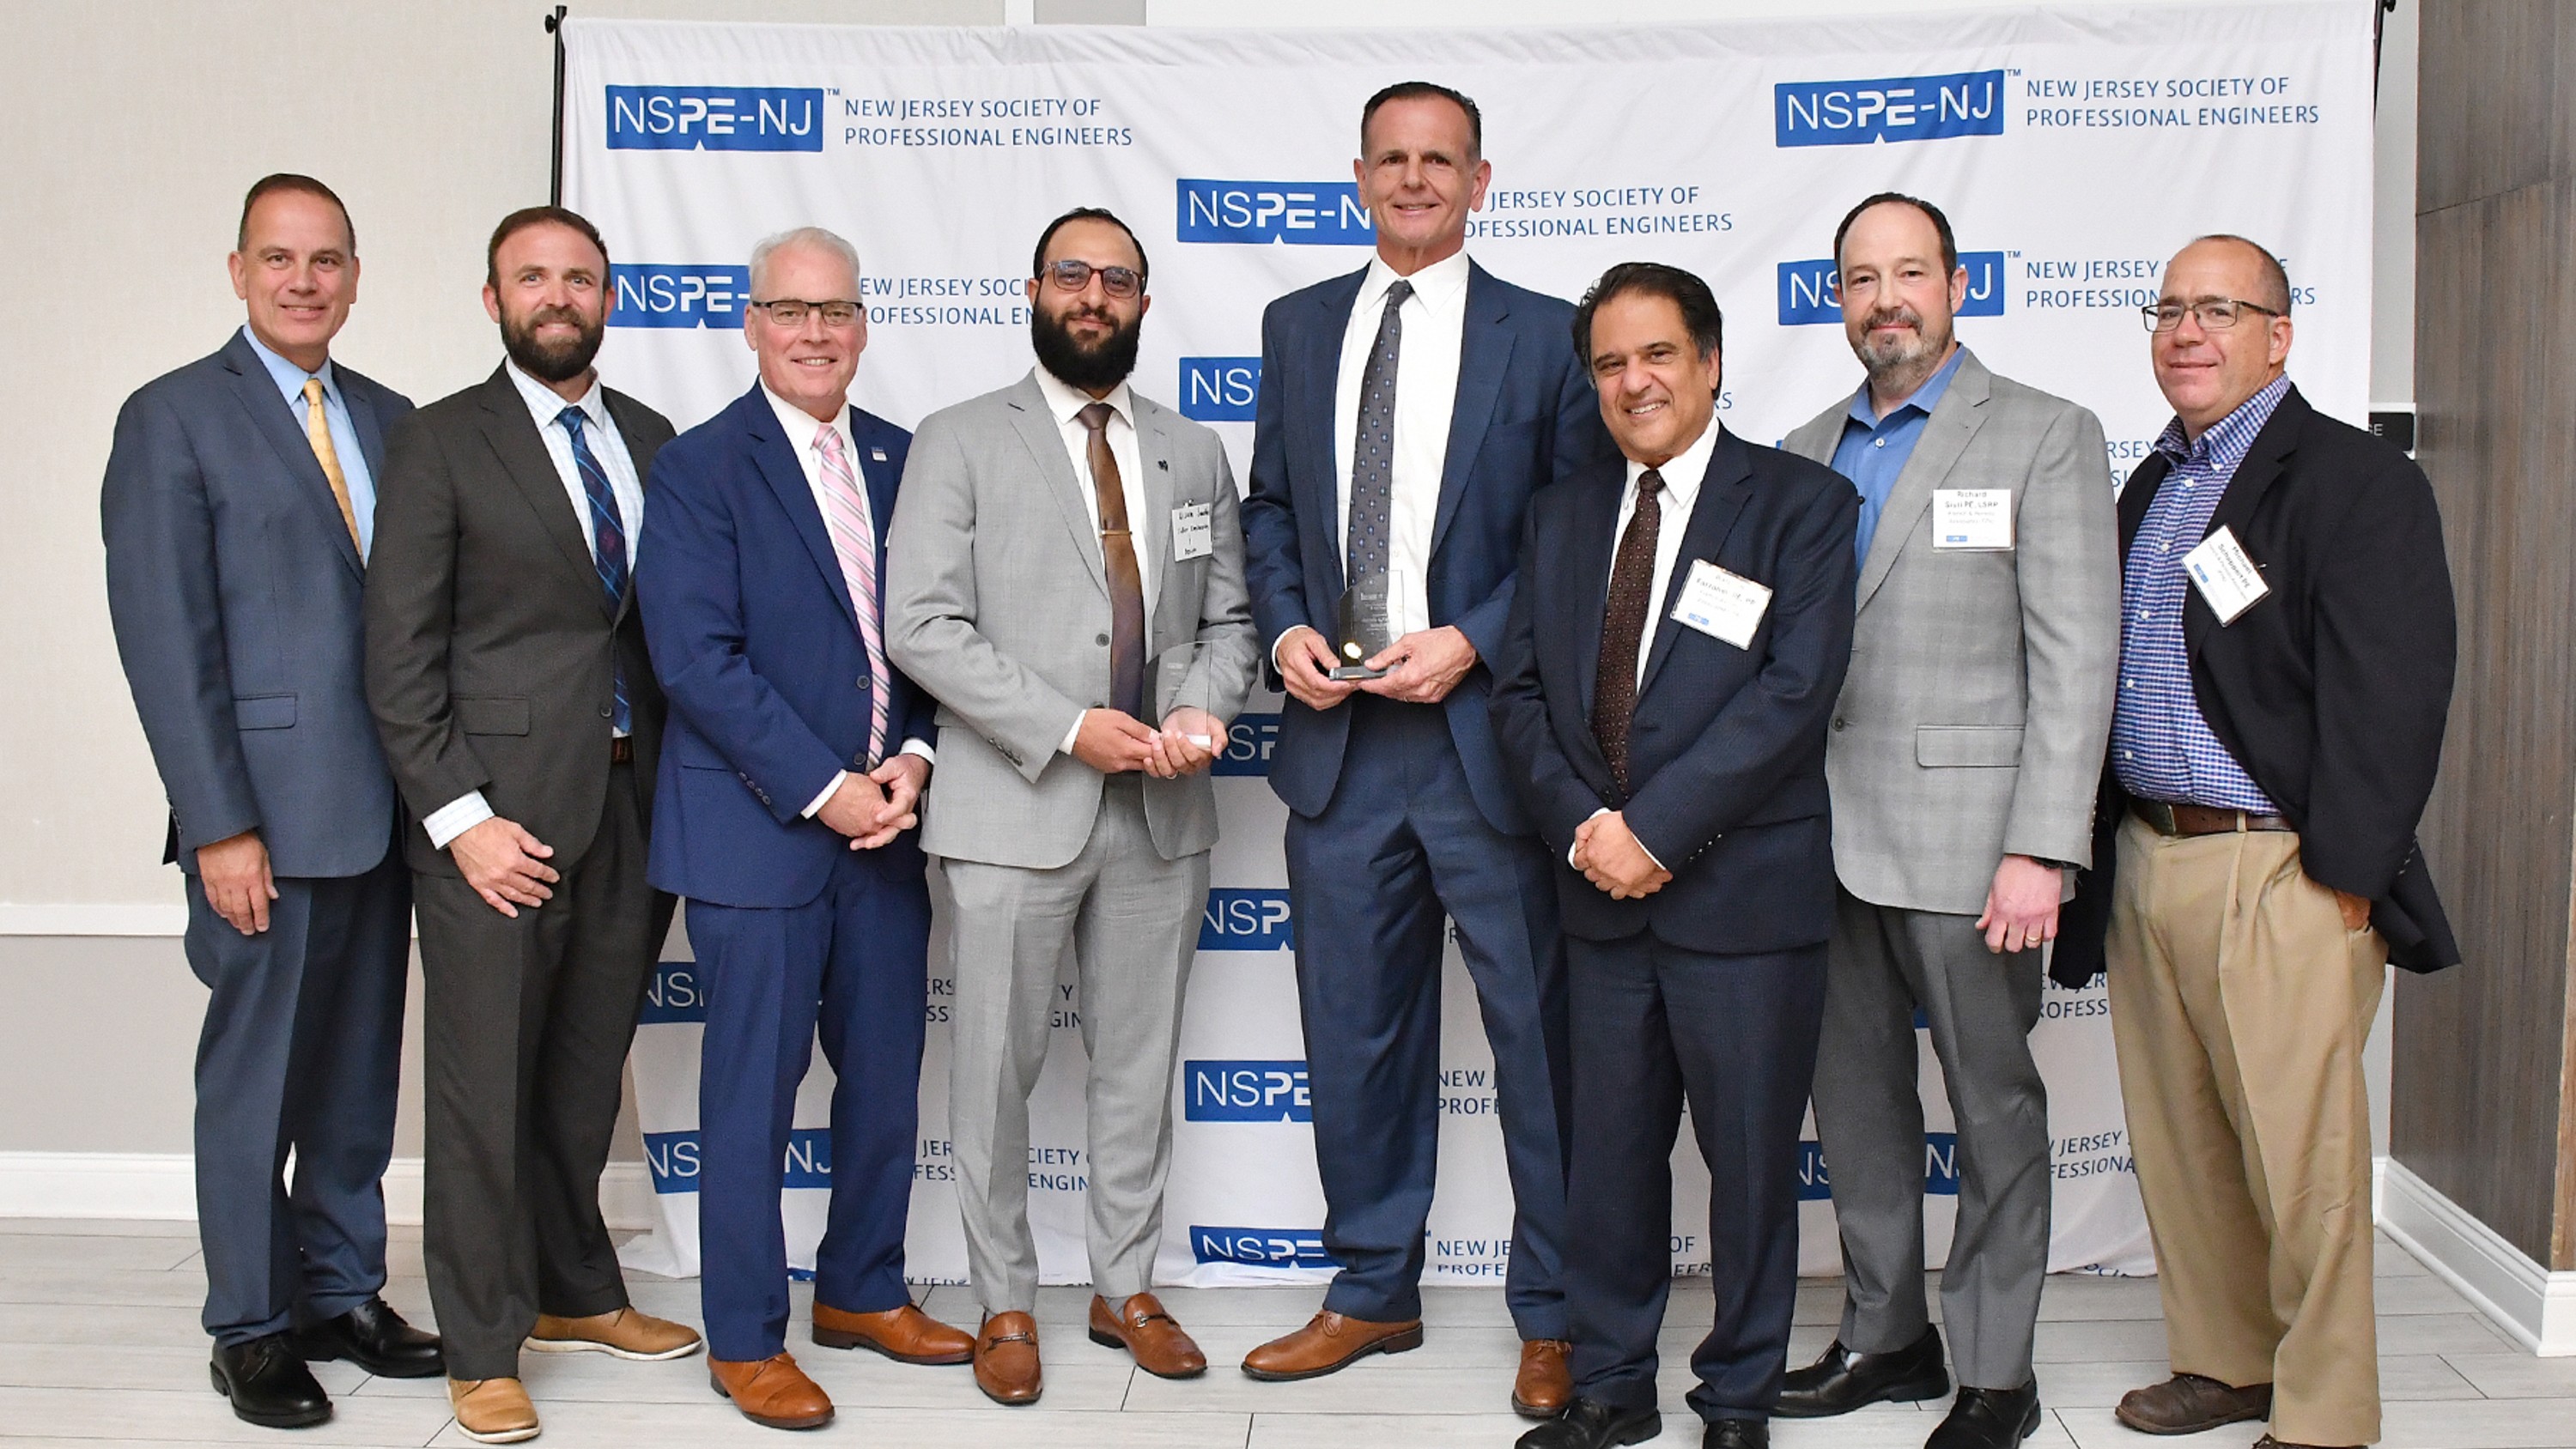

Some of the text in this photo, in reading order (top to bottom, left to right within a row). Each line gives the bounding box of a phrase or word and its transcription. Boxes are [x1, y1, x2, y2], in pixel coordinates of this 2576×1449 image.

[2026, 77, 2289, 101] NEW JERSEY SOCIETY OF
[615, 96, 811, 136] NSPE-NJ
[845, 100, 1102, 121] NEW JERSEY SOCIETY OF
[1788, 82, 1993, 130] NSPE-NJ
[2026, 106, 2319, 127] PROFESSIONAL ENGINEERS
[845, 127, 1133, 146] PROFESSIONAL ENGINEERS
[1189, 191, 1370, 229] NSPE-N
[1489, 186, 1699, 213] JERSEY SOCIETY OF
[1464, 214, 1733, 238] OFESSIONAL ENGINEERS
[2026, 261, 2077, 279] NEW
[2082, 261, 2160, 282] JERSEY
[617, 275, 750, 312] NSPE-
[861, 279, 1029, 300] EW JERSEY SOCI
[2026, 289, 2160, 308] PROFESSION
[866, 306, 1005, 324] OFESSIONAL
[1197, 1071, 1313, 1106] NSPE
[1439, 1070, 1485, 1088] NEW
[922, 1140, 952, 1159] JER
[2057, 1131, 2122, 1157] JERSEY
[2050, 1155, 2136, 1179] ESSIONA
[1029, 1173, 1087, 1191] ENGIN
[1202, 1234, 1325, 1260] NSPE
[1437, 1240, 1486, 1256] NEW
